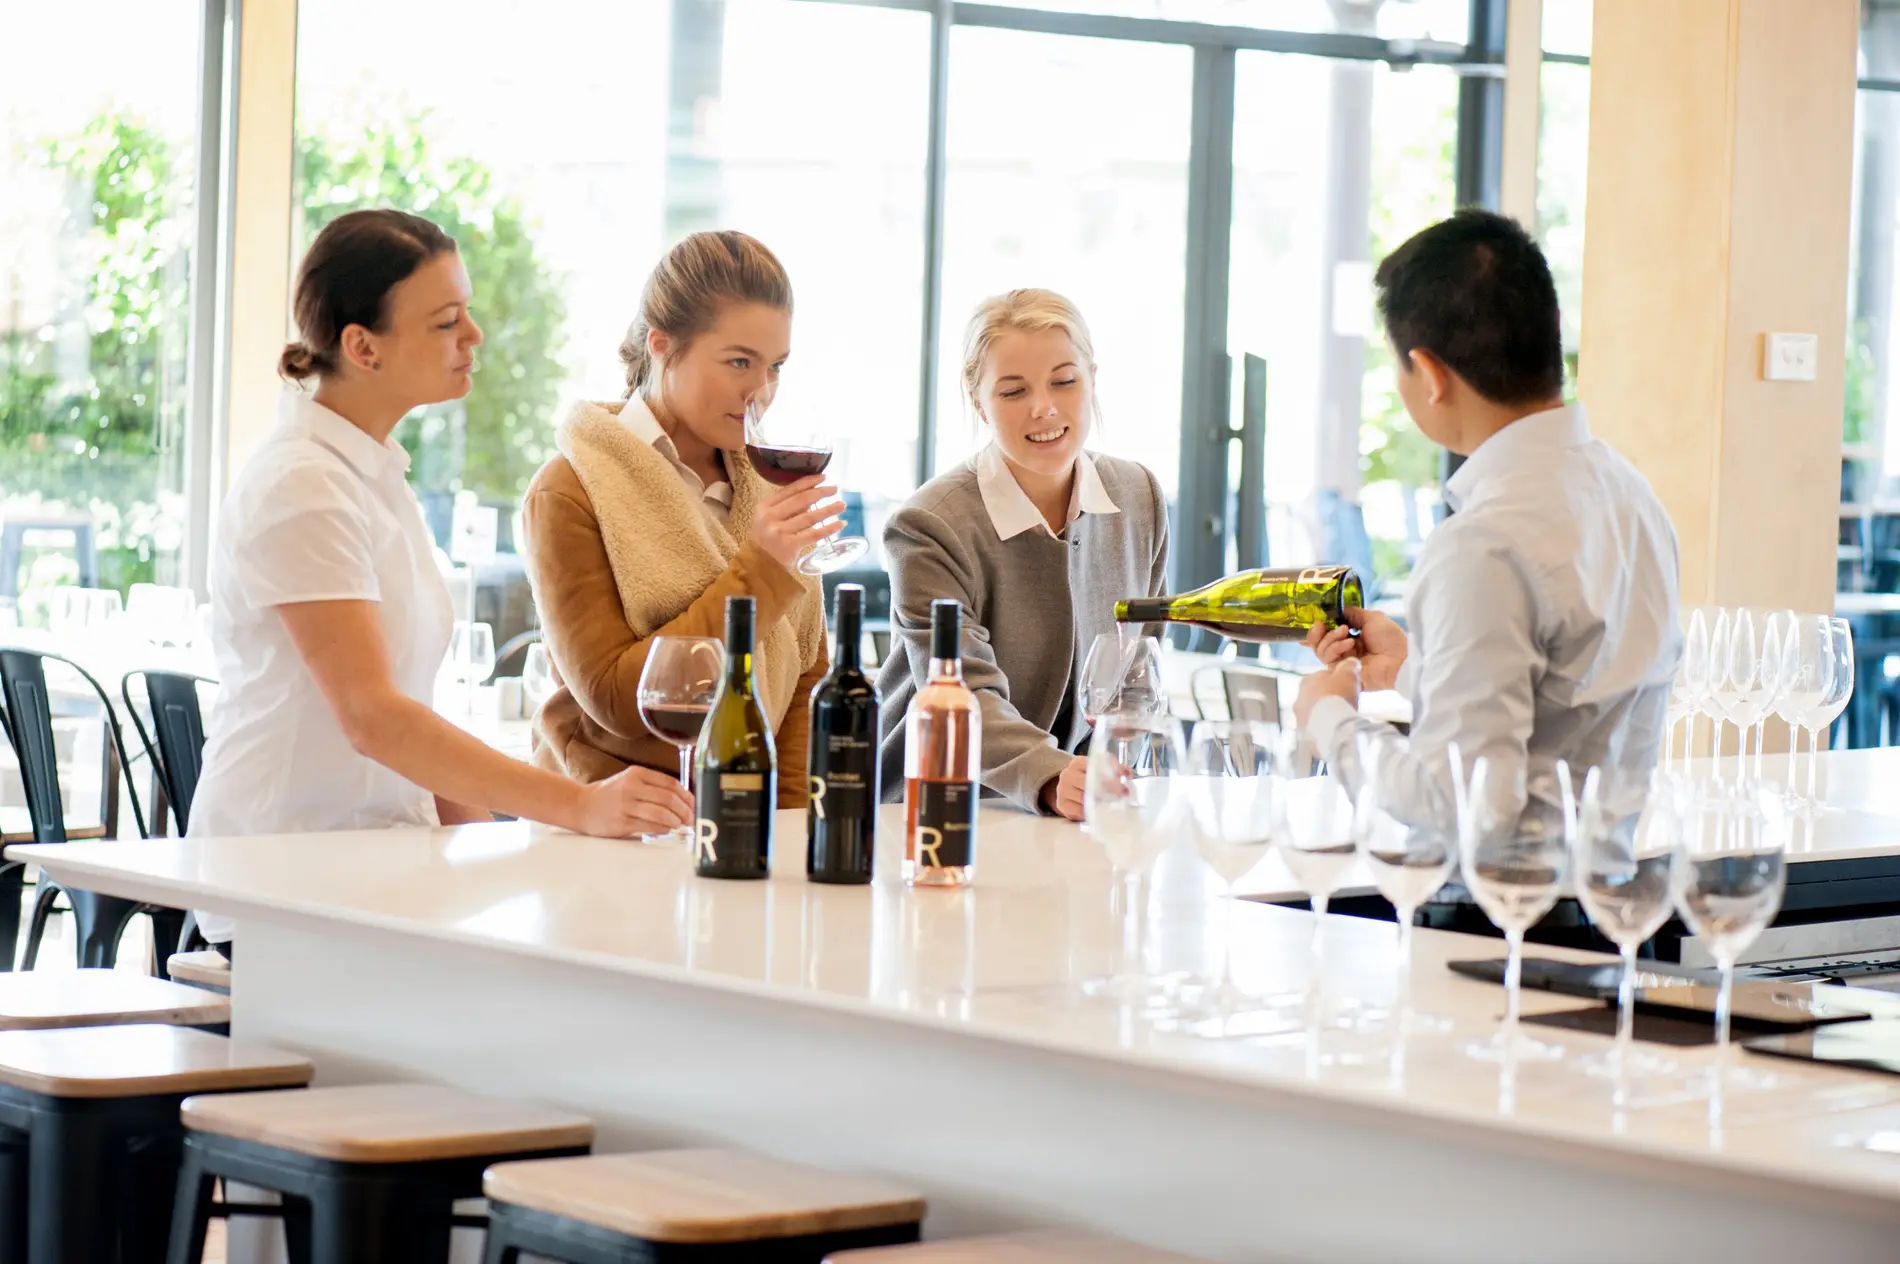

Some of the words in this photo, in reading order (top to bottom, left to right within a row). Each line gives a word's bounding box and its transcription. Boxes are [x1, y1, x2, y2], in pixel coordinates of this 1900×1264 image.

[1297, 567, 1339, 584] R
[808, 775, 827, 819] R
[695, 817, 719, 862] R
[915, 826, 943, 869] R
